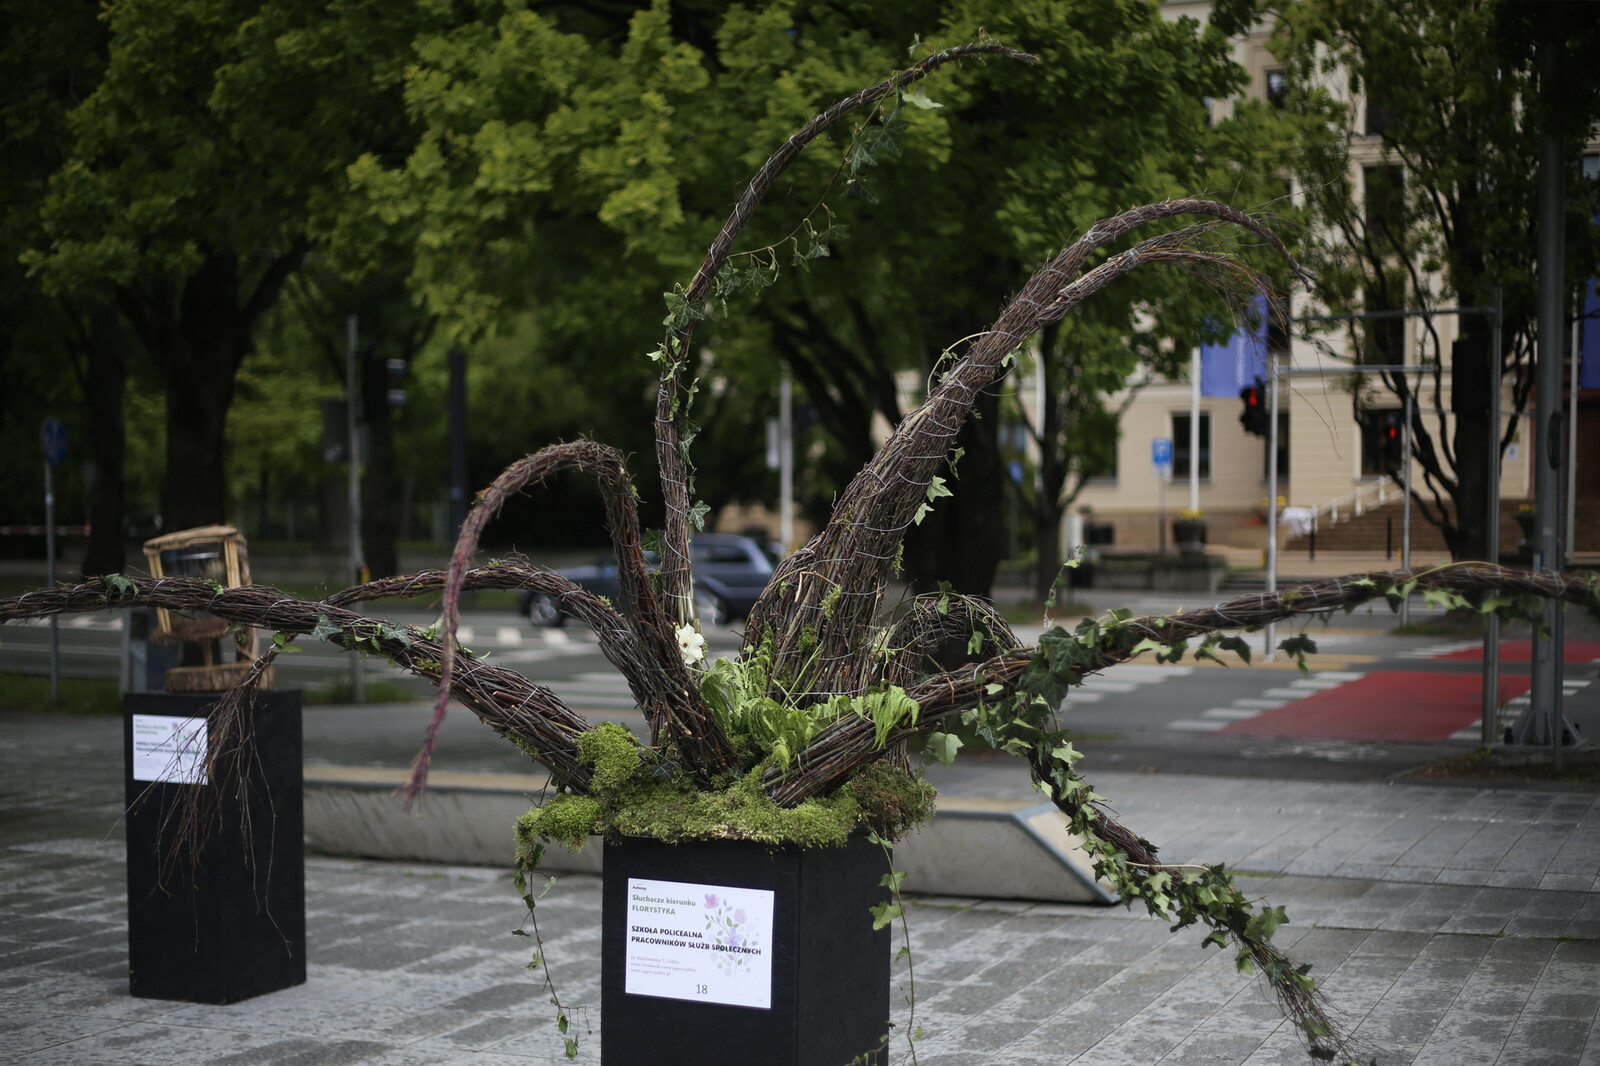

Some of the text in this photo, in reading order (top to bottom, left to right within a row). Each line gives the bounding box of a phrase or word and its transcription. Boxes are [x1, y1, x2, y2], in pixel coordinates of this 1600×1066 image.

[632, 894, 696, 907] Słuchacze kierunku
[632, 905, 676, 915] FLORYSTYKA
[631, 925, 703, 939] SZKOŁA POLICEALNA
[631, 936, 762, 956] PRACOWNIKÓW SŁUŻB SPOŁECZNYCH
[696, 984, 708, 995] 18
